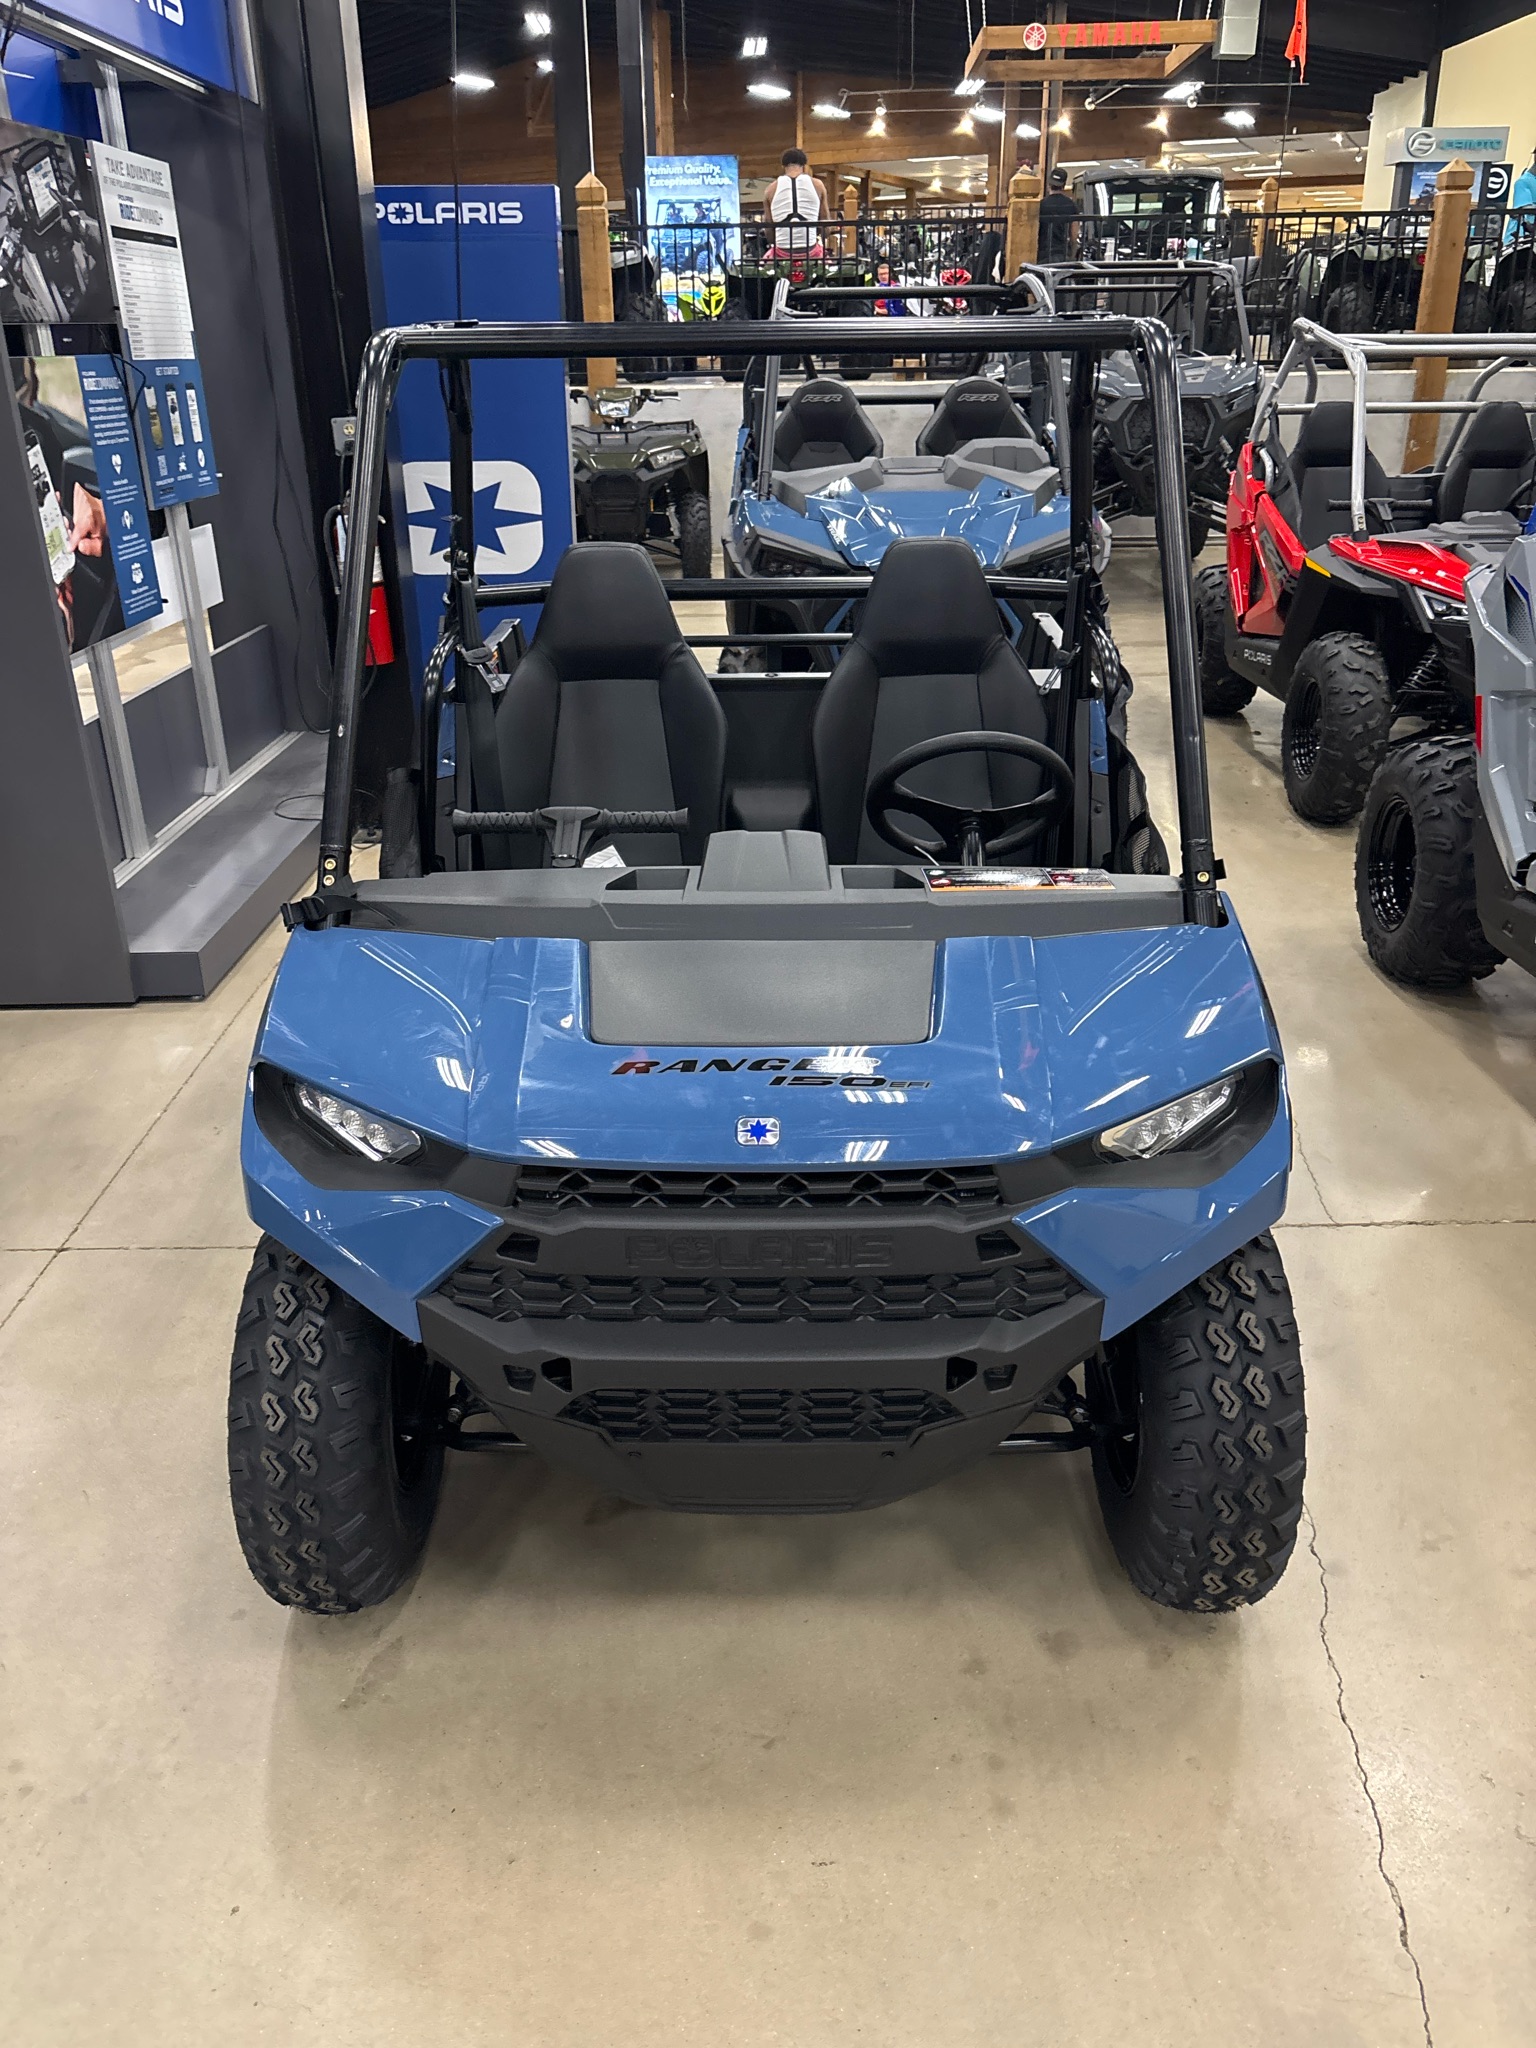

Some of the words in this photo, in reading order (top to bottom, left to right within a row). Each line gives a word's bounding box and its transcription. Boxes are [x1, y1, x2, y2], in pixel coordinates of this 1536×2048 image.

[1057, 21, 1162, 47] YAMAHA
[105, 157, 126, 176] TAKE
[126, 162, 164, 187] ADVANTAGE
[645, 164, 683, 176] Premium
[649, 176, 703, 188] Exceptional
[801, 394, 843, 403] RZR
[957, 394, 999, 402] RZR
[1243, 648, 1272, 666] POLARIS
[768, 1075, 888, 1087] 150
[625, 1233, 893, 1270] POLARIS
